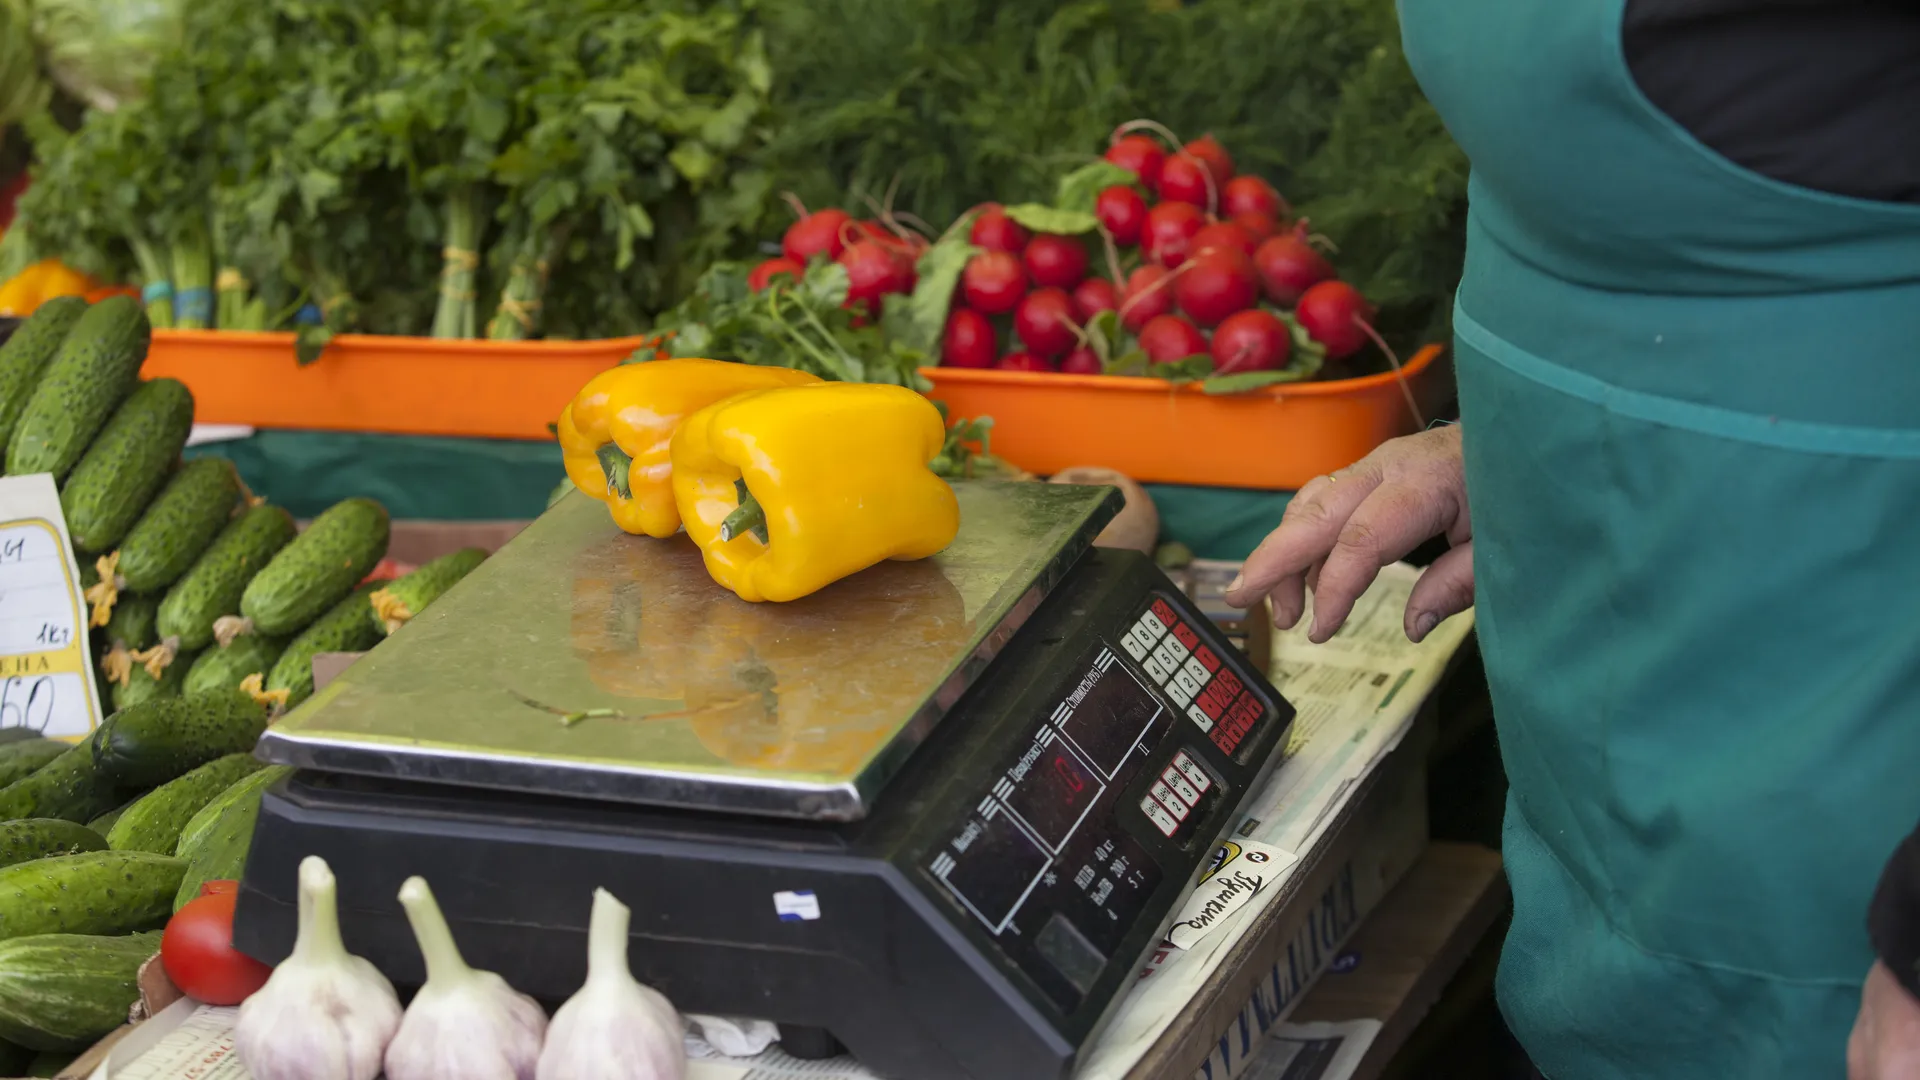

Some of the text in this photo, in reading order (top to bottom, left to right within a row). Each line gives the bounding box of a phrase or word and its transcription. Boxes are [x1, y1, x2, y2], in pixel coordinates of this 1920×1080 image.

[1149, 618, 1159, 630] 9
[1139, 629, 1150, 641] 8
[1128, 641, 1138, 652] 7
[1171, 641, 1181, 653] 6
[1161, 653, 1171, 665] 5
[1152, 665, 1162, 676] 4
[1192, 665, 1203, 677] 3
[1183, 677, 1194, 689] 2
[1173, 689, 1183, 699] 1
[1195, 712, 1206, 724] 0
[1194, 773, 1203, 782] 4
[1183, 788, 1192, 797] 3
[1172, 801, 1182, 812] 2
[1161, 816, 1170, 825] 1
[1095, 846, 1108, 861] 40
[1110, 859, 1126, 878] 200
[1127, 876, 1138, 889] 5
